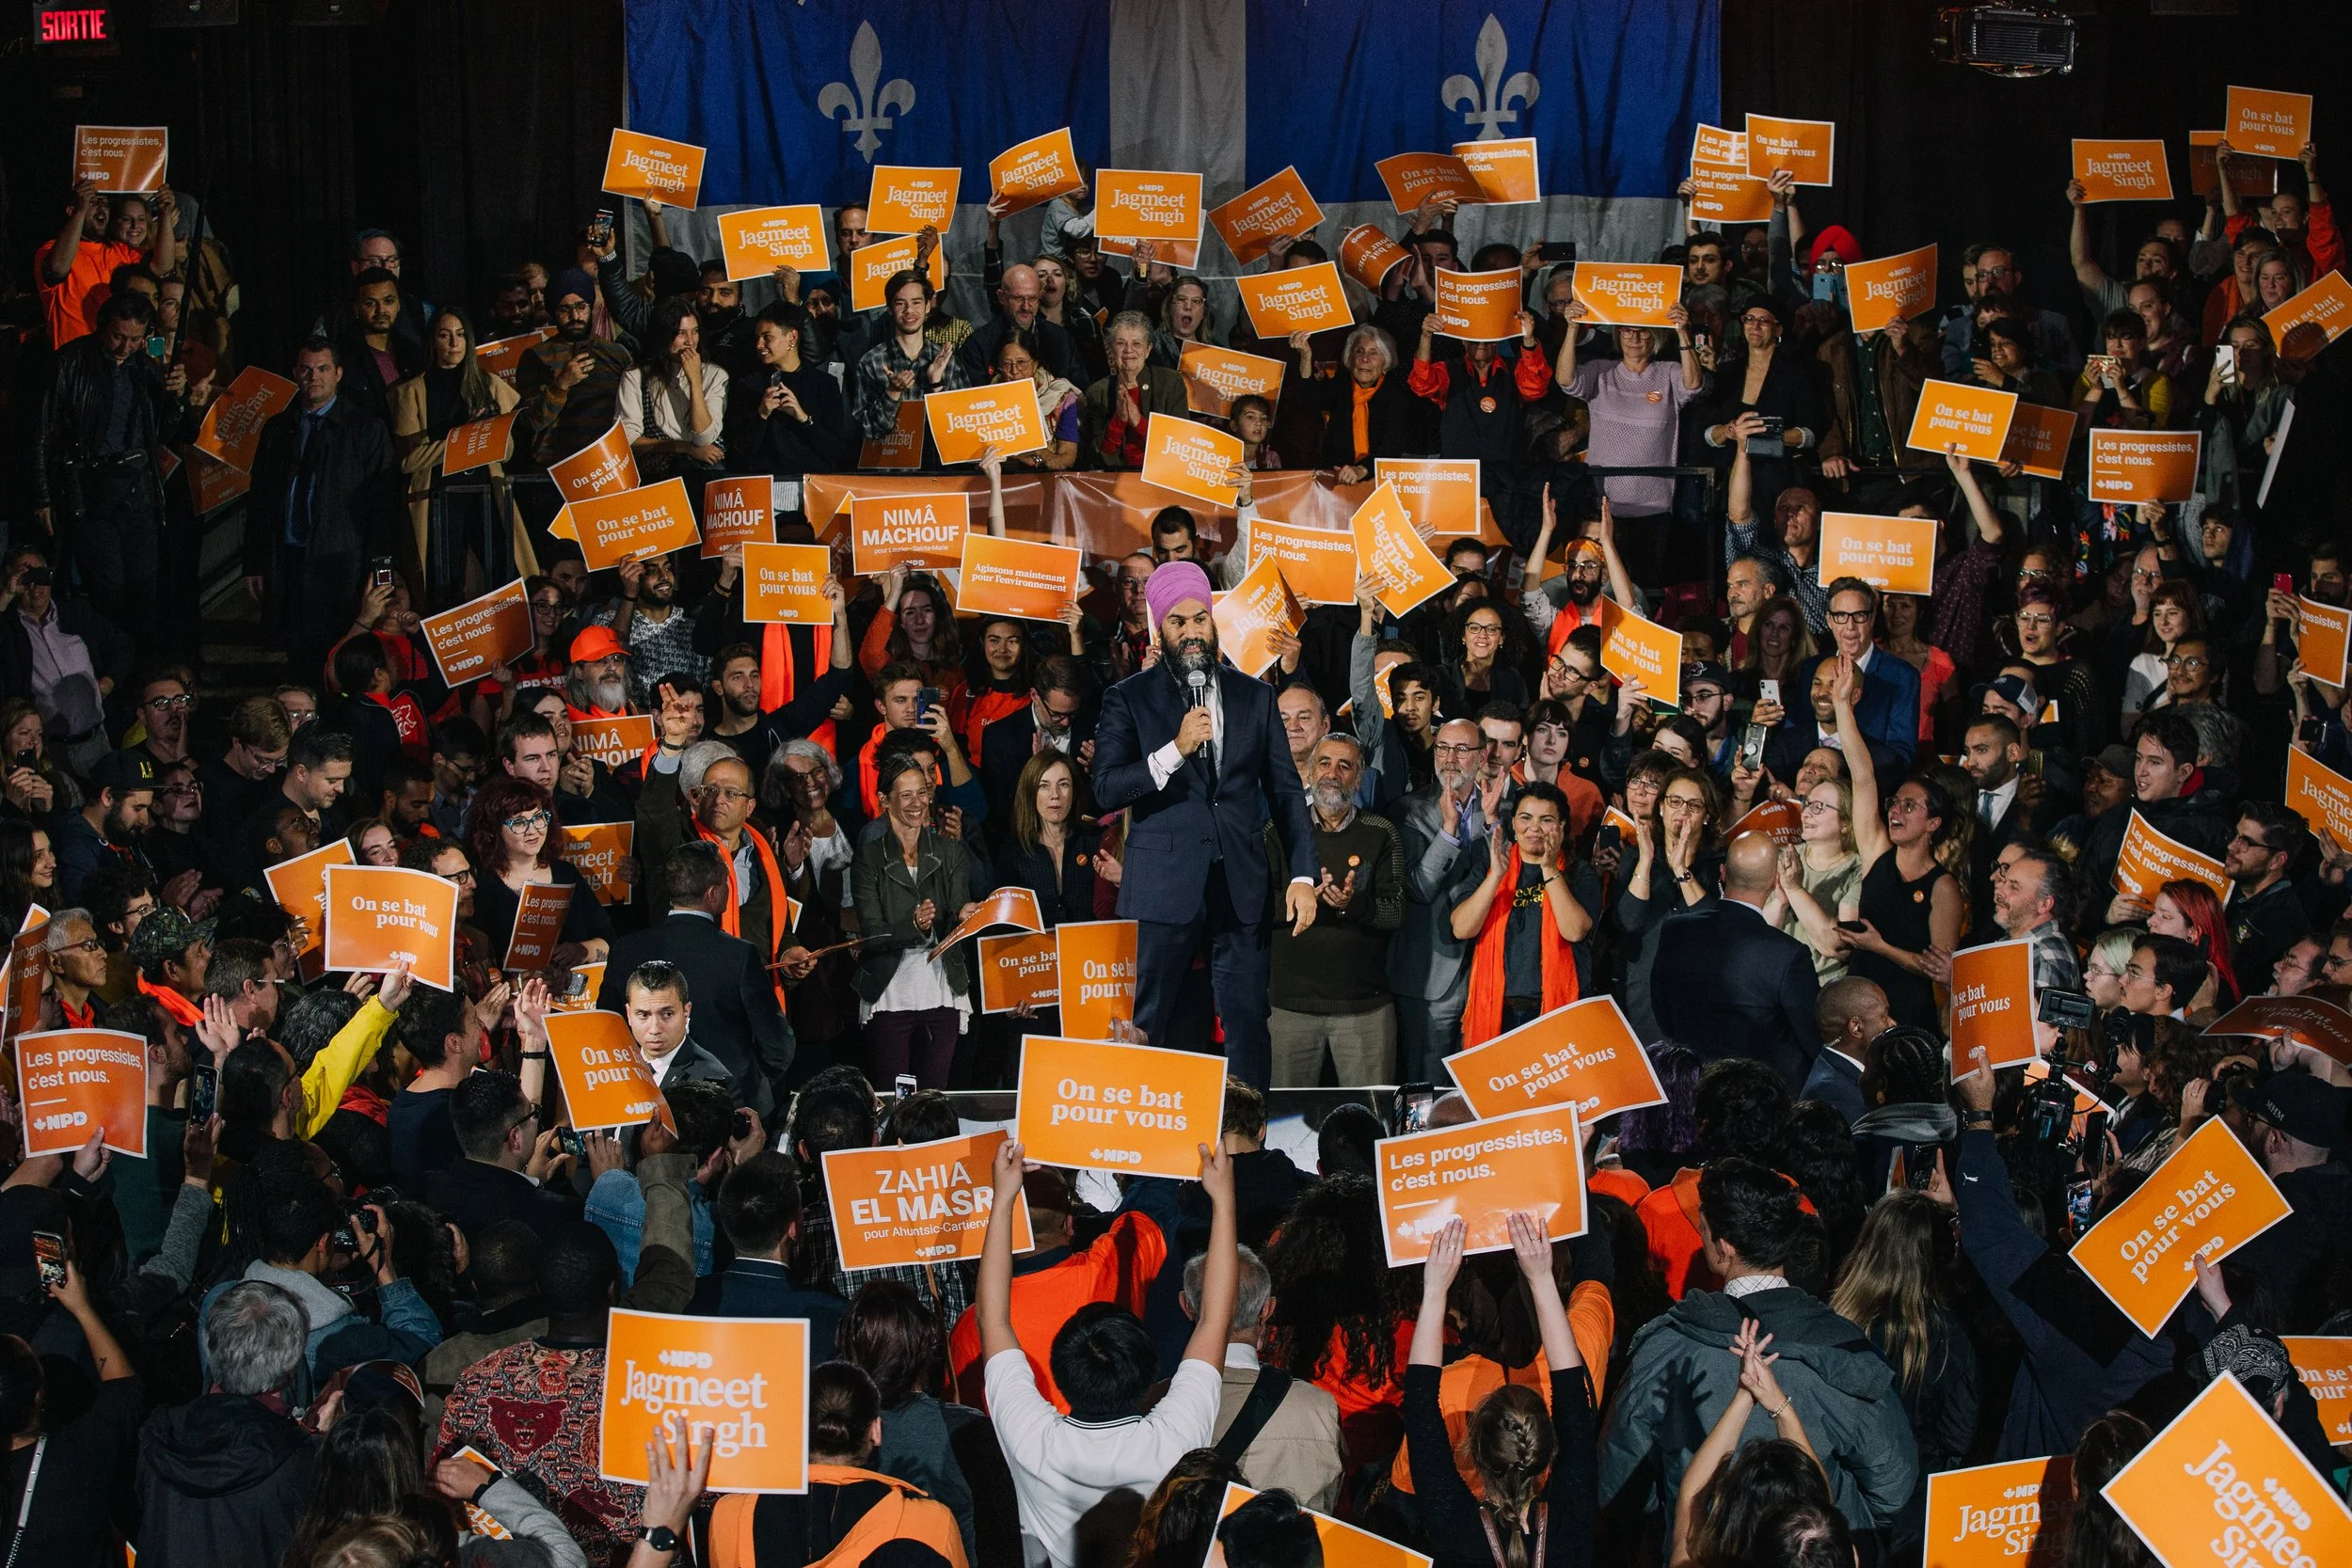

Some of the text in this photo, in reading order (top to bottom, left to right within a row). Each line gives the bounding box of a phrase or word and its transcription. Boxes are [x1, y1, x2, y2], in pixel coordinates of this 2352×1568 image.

[41, 9, 106, 41] SORTIE
[2241, 107, 2294, 124] On se bat
[2239, 120, 2295, 135] pour vous
[82, 135, 162, 148] Les progressistes,
[1756, 135, 1768, 145] On
[1780, 138, 1798, 148] bat
[1766, 145, 1817, 157] pour vous
[103, 148, 126, 158] nous.
[1464, 147, 1530, 162] progressistes,
[622, 150, 689, 179] Jagmeet
[1000, 150, 1060, 188] Jagmeet
[2086, 158, 2153, 175] Jagmeet
[645, 172, 686, 193] Singh
[1025, 166, 1066, 191] Singh
[2113, 173, 2155, 189] Singh
[884, 185, 947, 205] Jagmeet
[1111, 189, 1186, 211] Jagmeet
[910, 204, 946, 222] Singh
[1139, 208, 1185, 224] Singh
[1231, 191, 1296, 236] Jagmeet
[1262, 204, 1304, 236] Singh
[739, 226, 811, 249] Jagmeet
[770, 240, 813, 258] Singh
[1439, 277, 1518, 294] Les progressistes,
[1588, 276, 1664, 295] Jagmeet
[1256, 285, 1328, 310] Jagmeet
[1440, 290, 1489, 306] c'est nous.
[1616, 294, 1663, 312] Singh
[1288, 300, 1333, 320] Singh
[946, 403, 1023, 433] Jagmeet
[1934, 404, 1994, 424] On se bat
[977, 422, 1026, 443] Singh
[1929, 416, 1993, 436] pour vous
[1161, 436, 1232, 468] Jagmeet
[2097, 440, 2194, 456] Les progressistes,
[2097, 453, 2154, 467] c'est nous.
[1186, 462, 1228, 487] Singh
[1380, 468, 1472, 483] Les progressistes,
[714, 488, 744, 510] NIMÂ
[596, 505, 669, 531] On se bat
[707, 510, 764, 530] MACHOUF
[883, 504, 937, 526] NIMÂ
[597, 516, 675, 546] pour vous
[862, 525, 959, 546] MACHOUF
[1254, 529, 1355, 554] Les progressistes,
[1253, 543, 1310, 562] c'est nous.
[1369, 509, 1424, 586] Jagmeet
[1841, 537, 1912, 554] On se bat
[1838, 551, 1915, 567] pour vous
[759, 568, 813, 582] On se bat
[971, 573, 1066, 593] pour l'environnement
[974, 562, 1066, 583] Agissons maintenant
[1371, 550, 1408, 595] Singh
[759, 583, 817, 596] pour vous
[432, 594, 523, 638] Les progressistes,
[437, 624, 495, 651] c'est nous.
[1612, 626, 1660, 660] On se bat
[457, 655, 484, 671] NPD
[1609, 639, 1662, 675] pour vous
[2126, 839, 2173, 879] c'est nous.
[2131, 823, 2224, 887] Les progressistes,
[352, 896, 426, 917] On se bat
[376, 913, 438, 938] pour vous
[999, 954, 1037, 968] On se
[1018, 963, 1051, 977] pour
[1968, 983, 1986, 1002] bat
[1980, 996, 2010, 1014] vous
[26, 1047, 143, 1071] Les progressistes,
[581, 1047, 629, 1067] On se
[1488, 1043, 1580, 1093] On se bat
[1522, 1046, 1616, 1100] pour vous
[28, 1070, 110, 1090] c'est nous.
[583, 1067, 631, 1092] pour
[1058, 1079, 1184, 1110] On se bat
[46, 1112, 88, 1130] NPD
[1051, 1101, 1187, 1132] pour vous
[1104, 1149, 1142, 1164] NPD
[1390, 1128, 1567, 1170] Les progressistes,
[876, 1161, 972, 1194] ZAHIA
[1391, 1164, 1496, 1193] c'est nous.
[850, 1185, 994, 1225] EL MASR
[2120, 1169, 2220, 1262] On se bat
[864, 1227, 889, 1242] pour
[2131, 1182, 2235, 1284] pour vous
[927, 1244, 956, 1257] NPD
[620, 1360, 768, 1416] Jagmeet
[662, 1410, 768, 1458] Sngh
[2271, 1485, 2312, 1531] NPD
